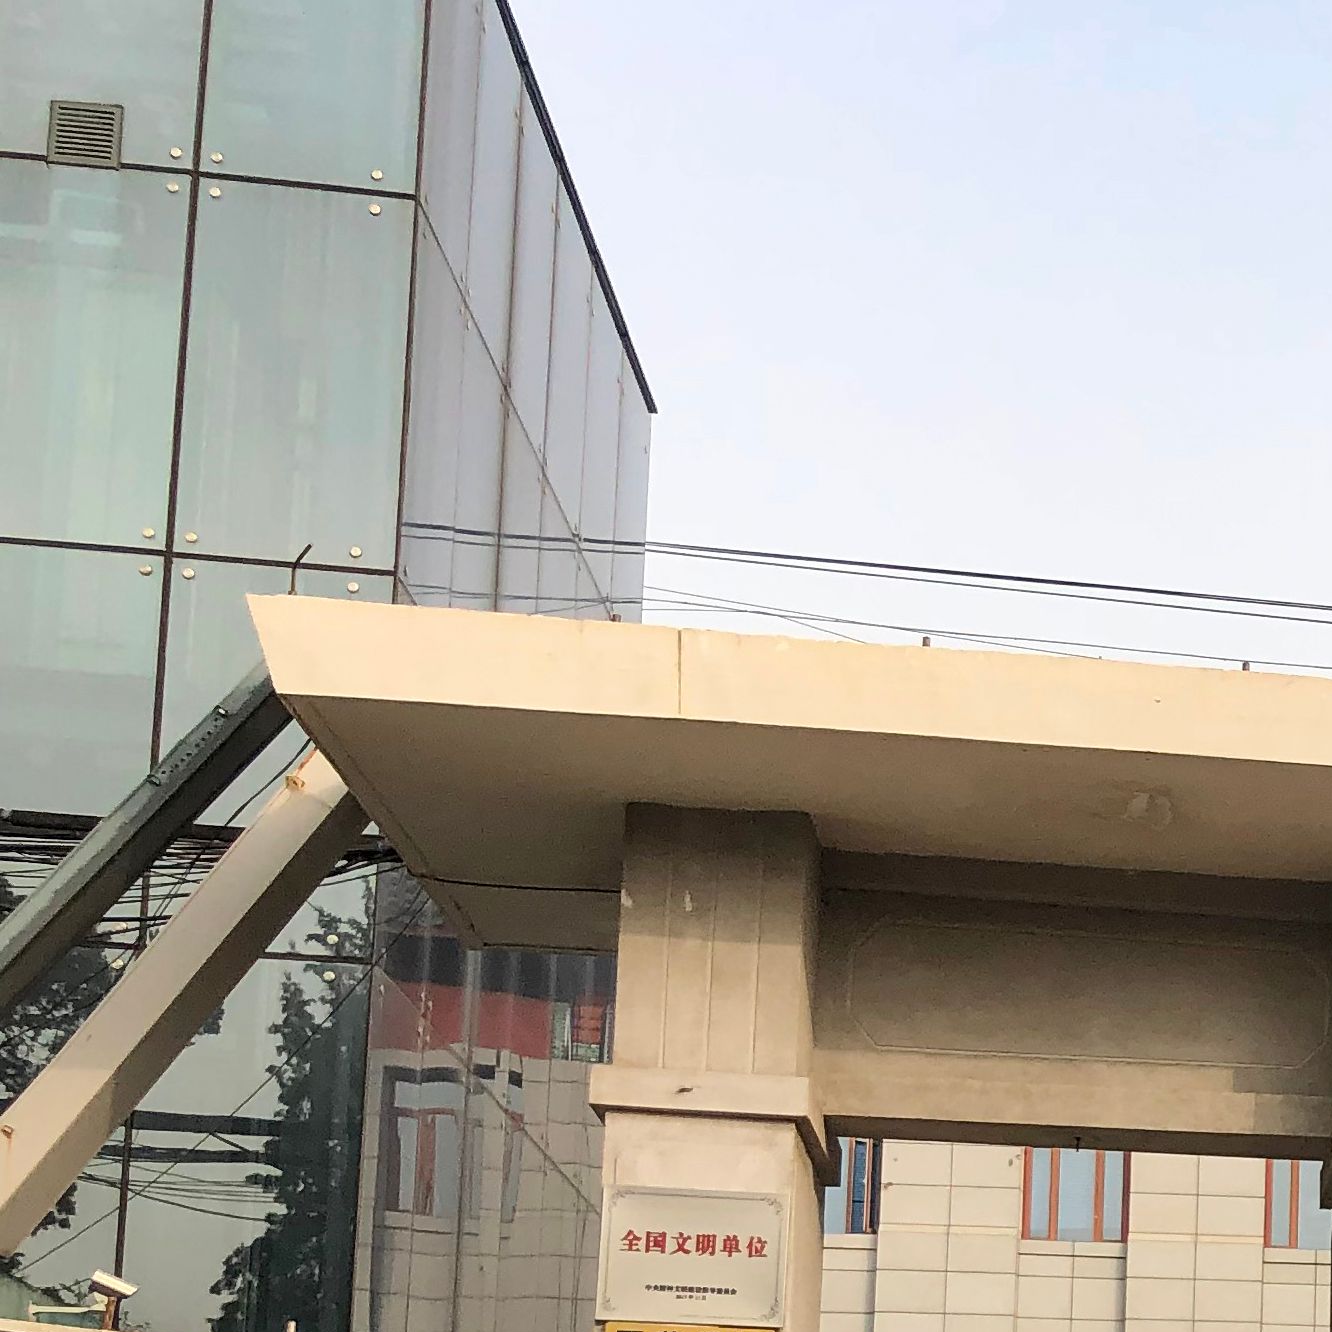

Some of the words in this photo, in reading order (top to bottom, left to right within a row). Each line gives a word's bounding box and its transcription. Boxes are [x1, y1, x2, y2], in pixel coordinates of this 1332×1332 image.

[620, 1230, 768, 1258] 全国文明单位
